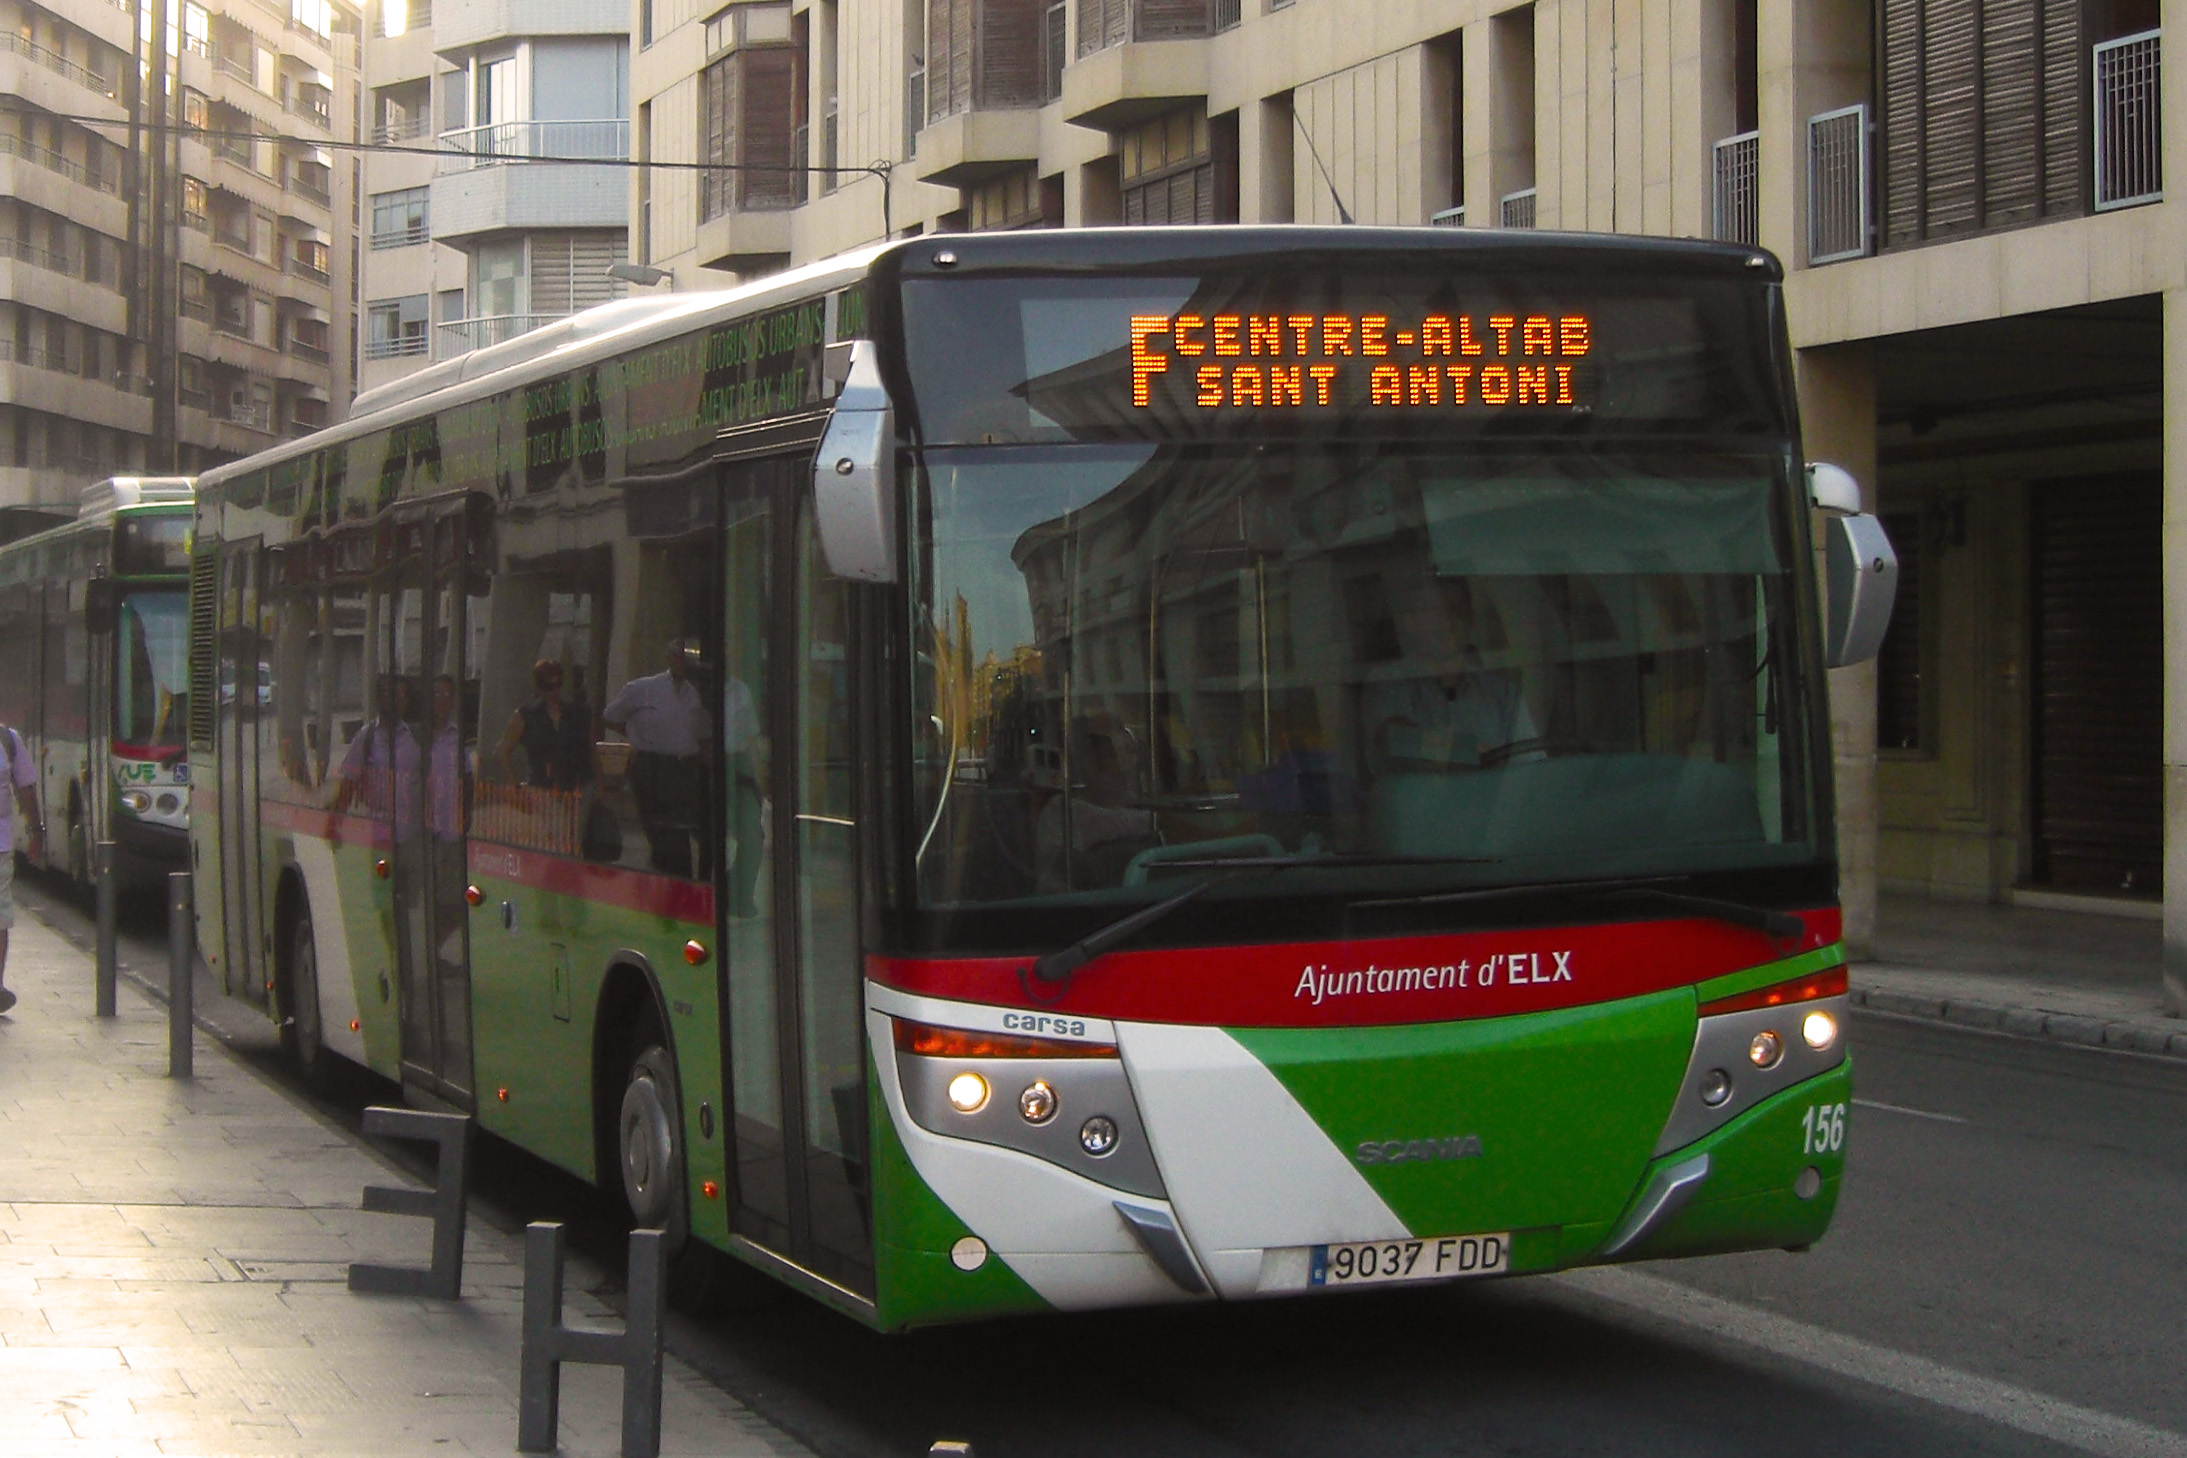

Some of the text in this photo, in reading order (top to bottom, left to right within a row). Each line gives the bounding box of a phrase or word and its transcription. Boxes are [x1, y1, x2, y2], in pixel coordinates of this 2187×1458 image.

[1130, 315, 1169, 406] F
[1196, 366, 1574, 406] SANT ANTONI
[1294, 950, 1573, 1006] Ajuntament d'ELX
[1003, 1013, 1085, 1037] carsa
[1356, 1134, 1483, 1166] SCANIA
[1802, 1103, 1845, 1154] 156
[1334, 1236, 1502, 1280] 9037 FDD
